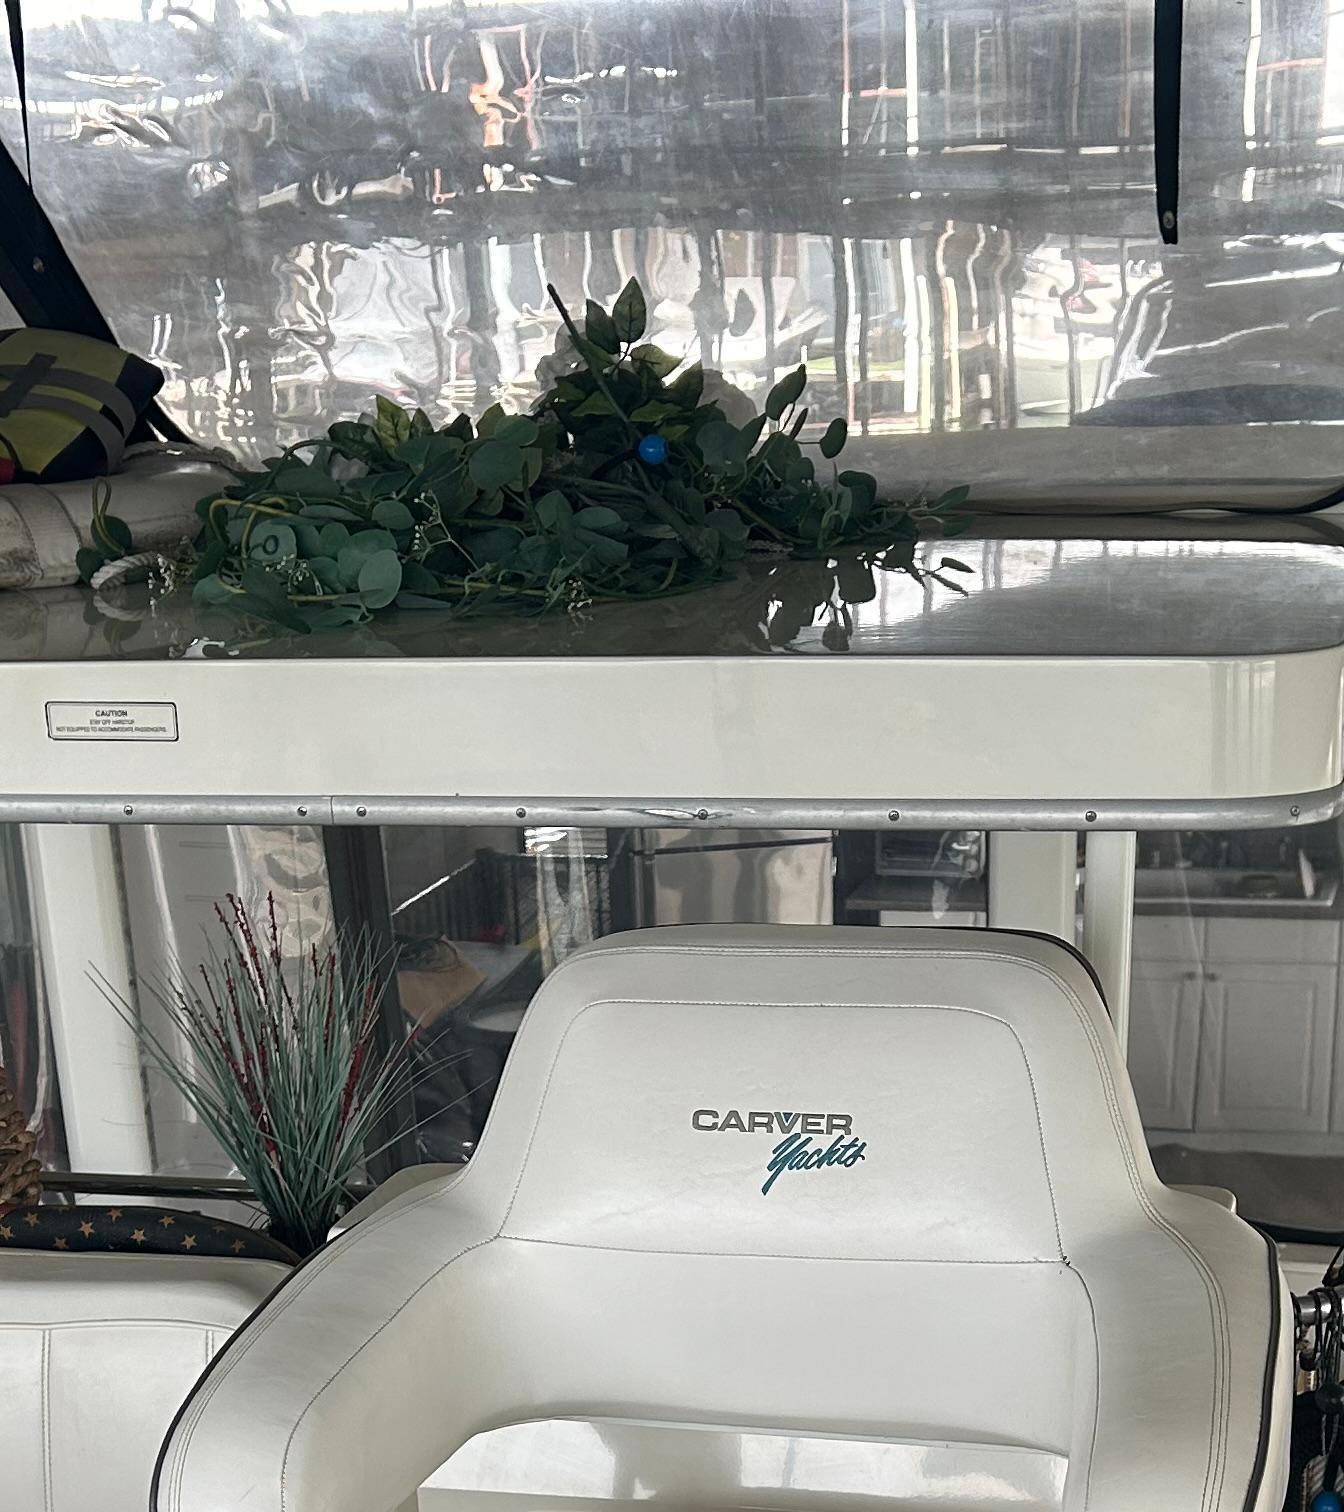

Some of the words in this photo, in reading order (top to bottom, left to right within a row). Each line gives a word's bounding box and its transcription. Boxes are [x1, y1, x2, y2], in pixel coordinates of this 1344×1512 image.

[95, 710, 128, 718] CAUTION
[692, 1109, 852, 1136] CARVER
[761, 1132, 868, 1196] Yachts
